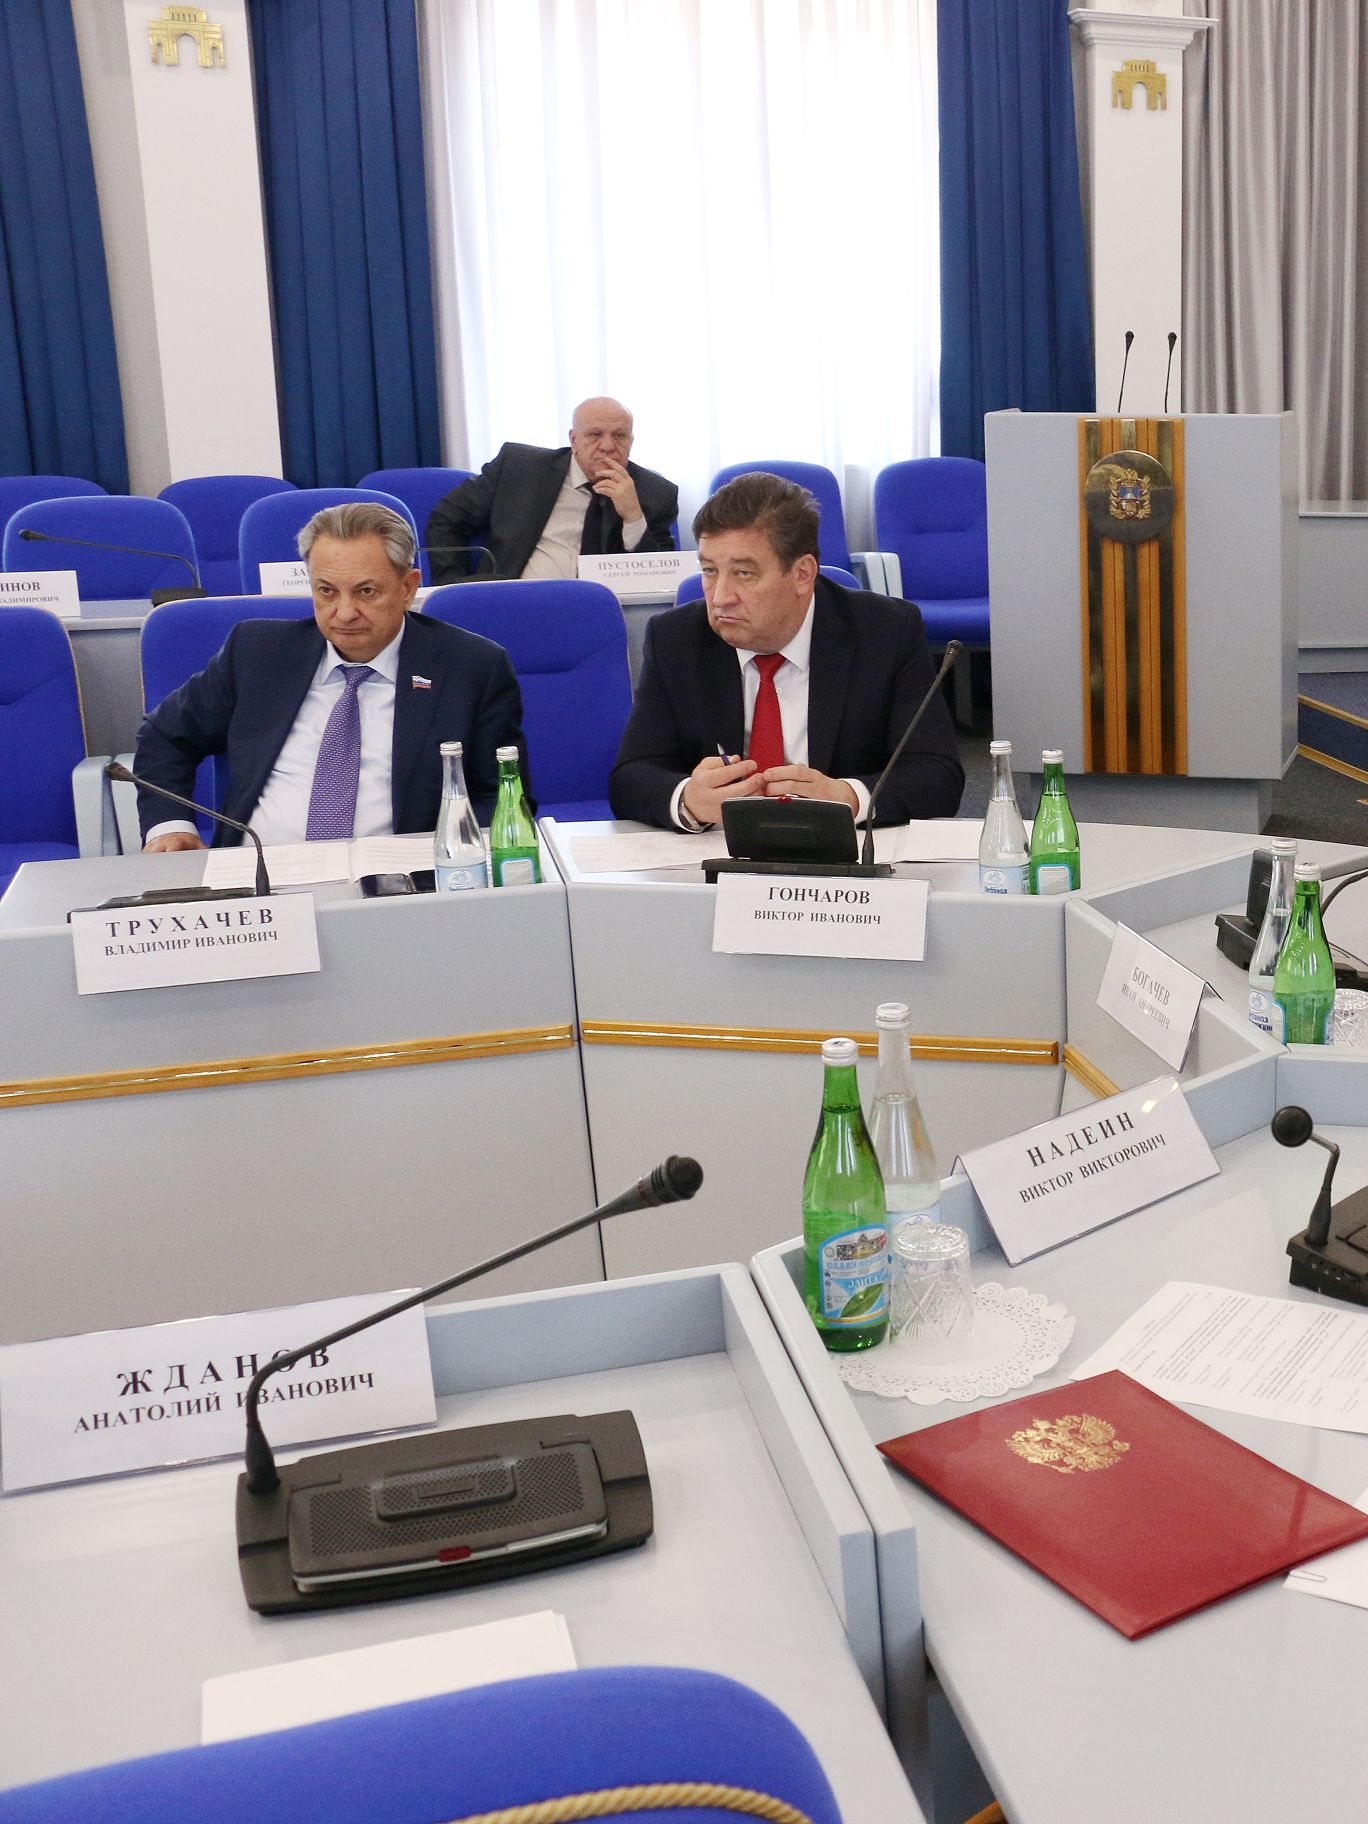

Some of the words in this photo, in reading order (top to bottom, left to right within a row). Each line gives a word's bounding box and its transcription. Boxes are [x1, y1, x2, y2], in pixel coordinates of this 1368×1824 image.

[598, 559, 680, 570] ПУСТОСЕЛОВ
[768, 886, 871, 905] ГОНЧАРОВ
[105, 908, 274, 938] ТРУХАЧЕВ
[753, 909, 805, 922] ВИКТОР
[810, 912, 881, 925] ИВАНОВИЧ
[104, 938, 191, 957] ВЛАДИМИР
[195, 930, 279, 948] ИВАНОВИЧ
[1131, 966, 1171, 1006] БОГАЧЕВ
[1026, 1111, 1135, 1168] НАДЕИН
[1018, 1171, 1074, 1204] ВИКТОР
[1078, 1133, 1168, 1180] ВИКТОРОВИЧ
[116, 1345, 330, 1397] ЖДАНОВ
[73, 1391, 222, 1434] АНАТОЛИЙ
[235, 1371, 375, 1409] ИВАНОВИЧ
